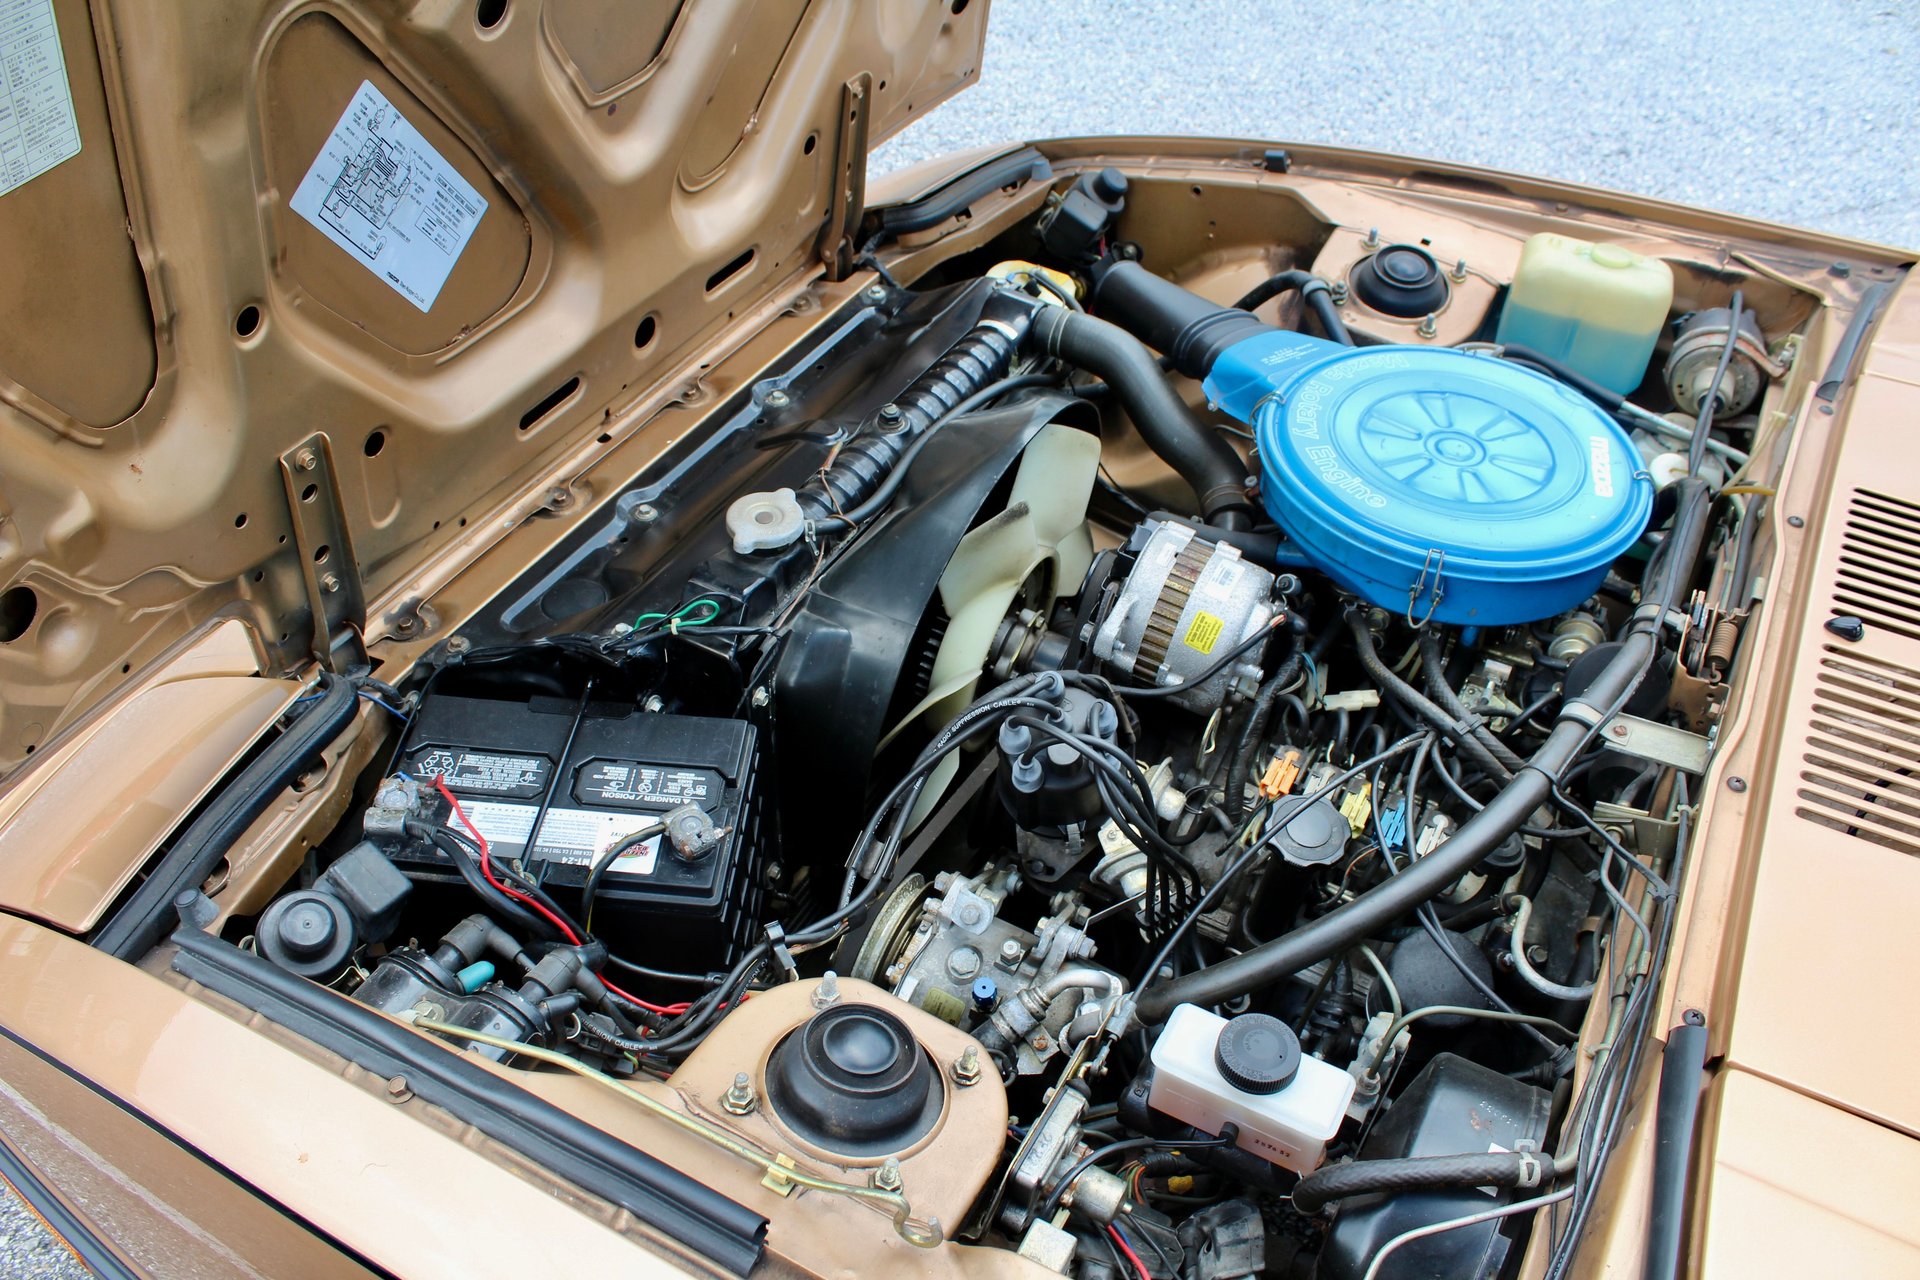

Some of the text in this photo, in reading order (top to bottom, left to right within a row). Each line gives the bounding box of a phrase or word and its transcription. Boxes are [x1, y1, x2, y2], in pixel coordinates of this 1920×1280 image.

[1292, 354, 1410, 508] Mazda Rotary Engine
[1589, 436, 1614, 497] mazda
[937, 731, 952, 749] RADIO
[951, 704, 991, 733] SUPPRESSION
[601, 790, 634, 800] POISON
[642, 794, 680, 804] DANGER
